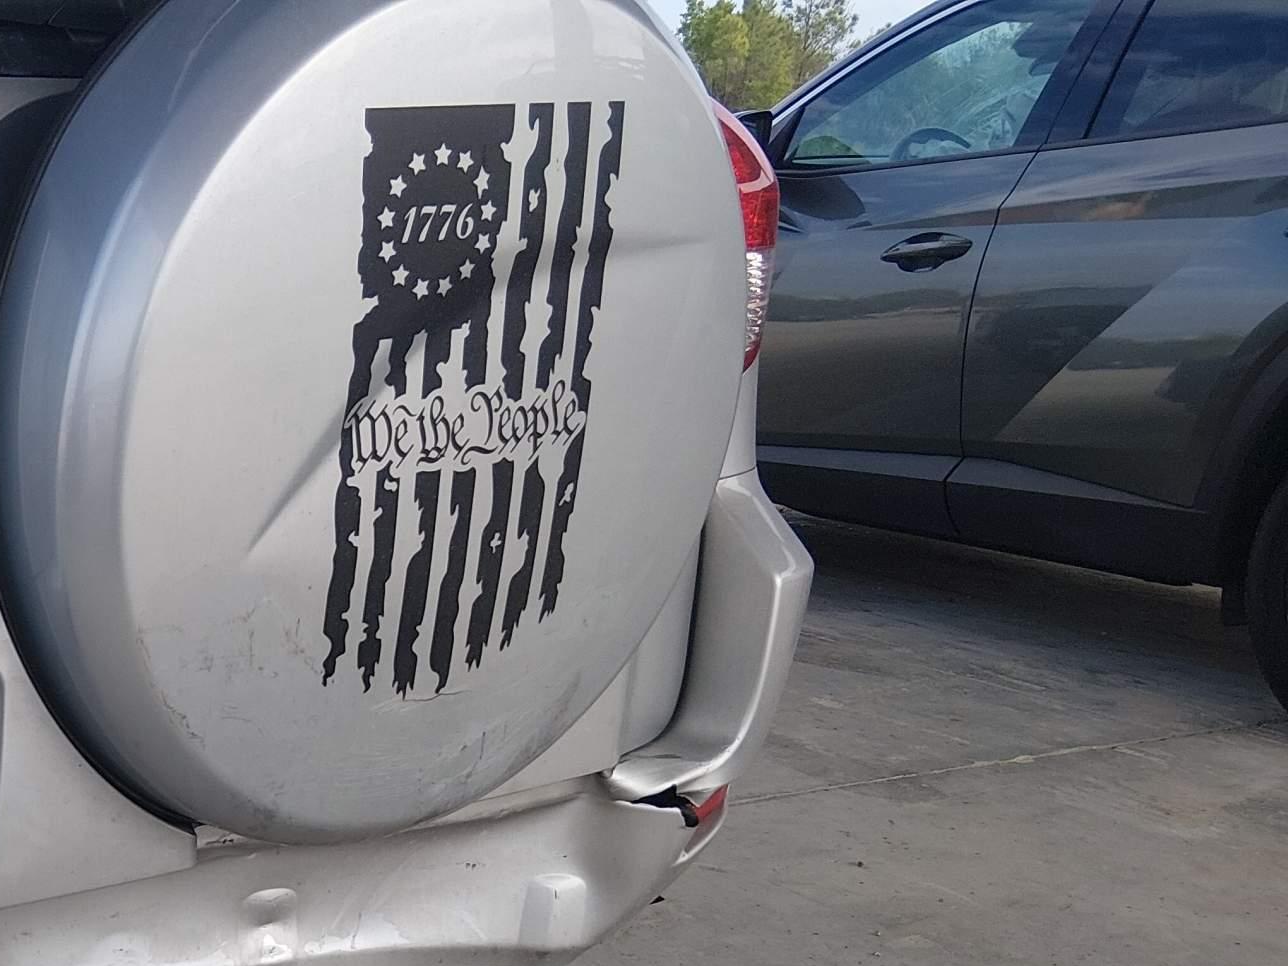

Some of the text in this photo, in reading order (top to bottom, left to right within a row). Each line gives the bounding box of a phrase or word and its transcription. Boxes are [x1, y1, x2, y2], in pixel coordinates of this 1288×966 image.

[401, 202, 474, 244] 1776
[346, 379, 583, 474] We the People
